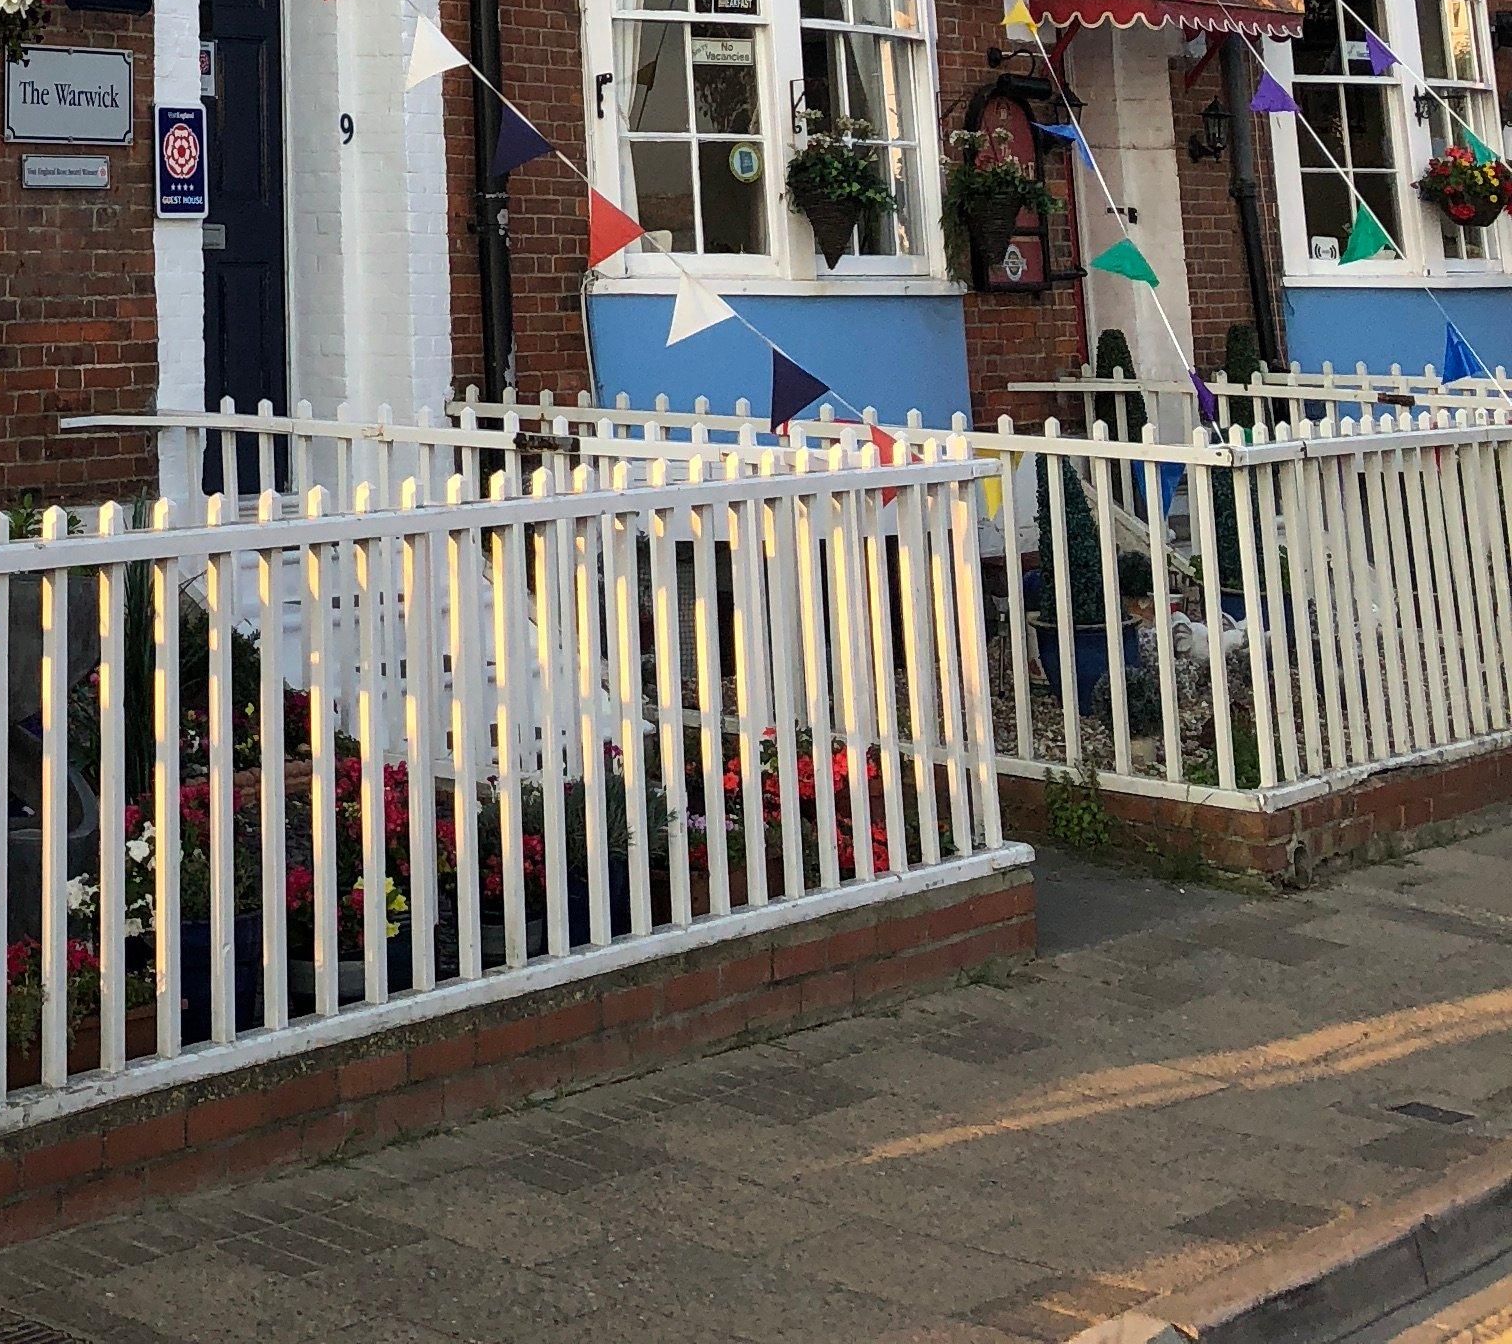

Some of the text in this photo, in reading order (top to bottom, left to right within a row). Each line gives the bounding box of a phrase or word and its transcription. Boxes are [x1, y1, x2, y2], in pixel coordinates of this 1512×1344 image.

[705, 51, 750, 62] Vacancies
[720, 41, 734, 52] No
[19, 80, 120, 109] The Warwick
[340, 113, 354, 145] 9
